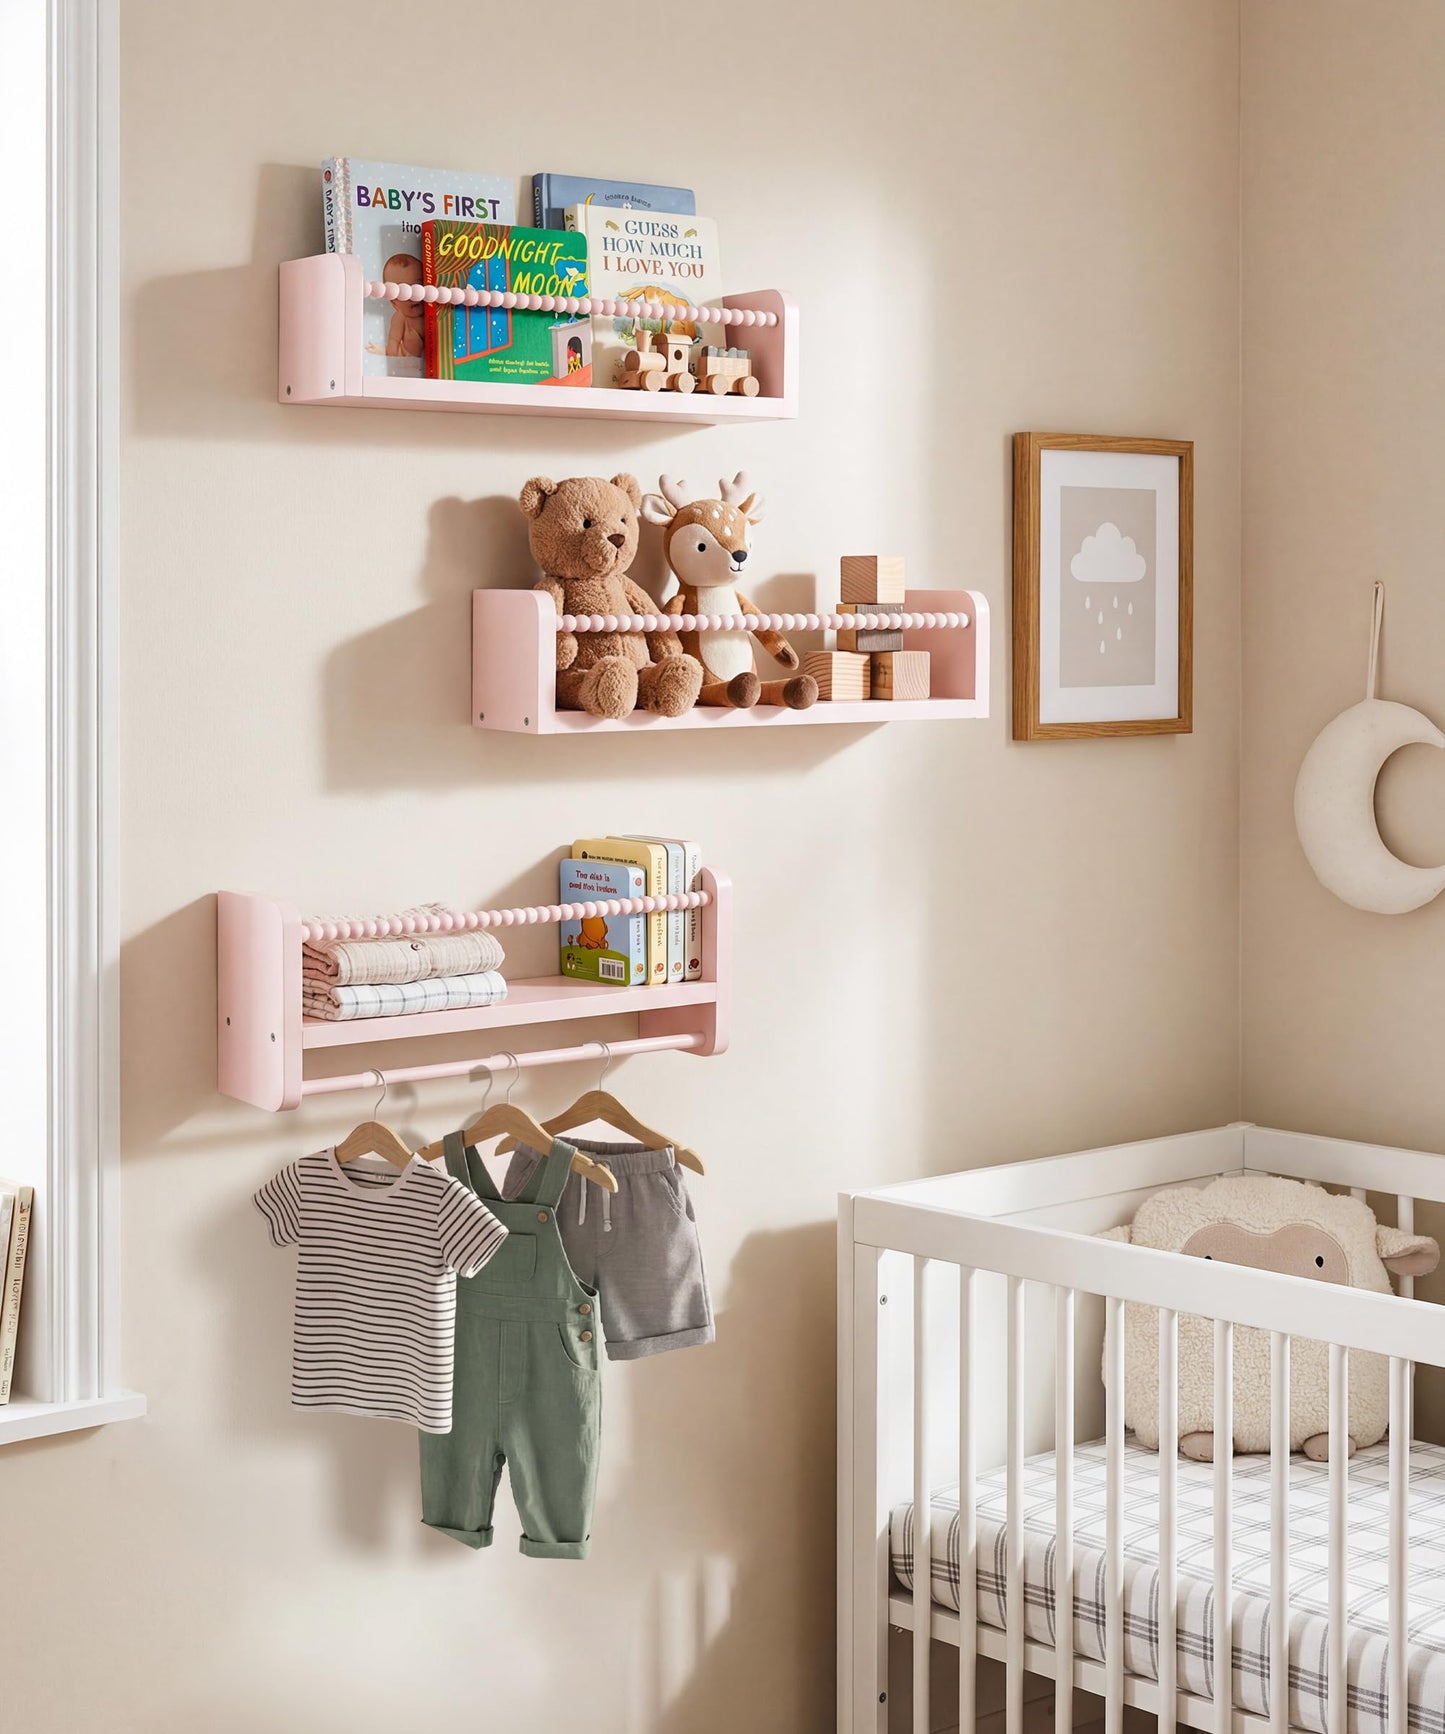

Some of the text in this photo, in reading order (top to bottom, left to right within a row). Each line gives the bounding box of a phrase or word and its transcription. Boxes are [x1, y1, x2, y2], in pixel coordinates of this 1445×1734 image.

[356, 185, 500, 220] BABY'S FIRST
[624, 220, 679, 239] GUESS
[439, 233, 564, 266] GOODNIGHT
[602, 236, 703, 259] HOW MUCH
[603, 256, 704, 279] I LOVE YOU
[512, 271, 575, 297] MOON
